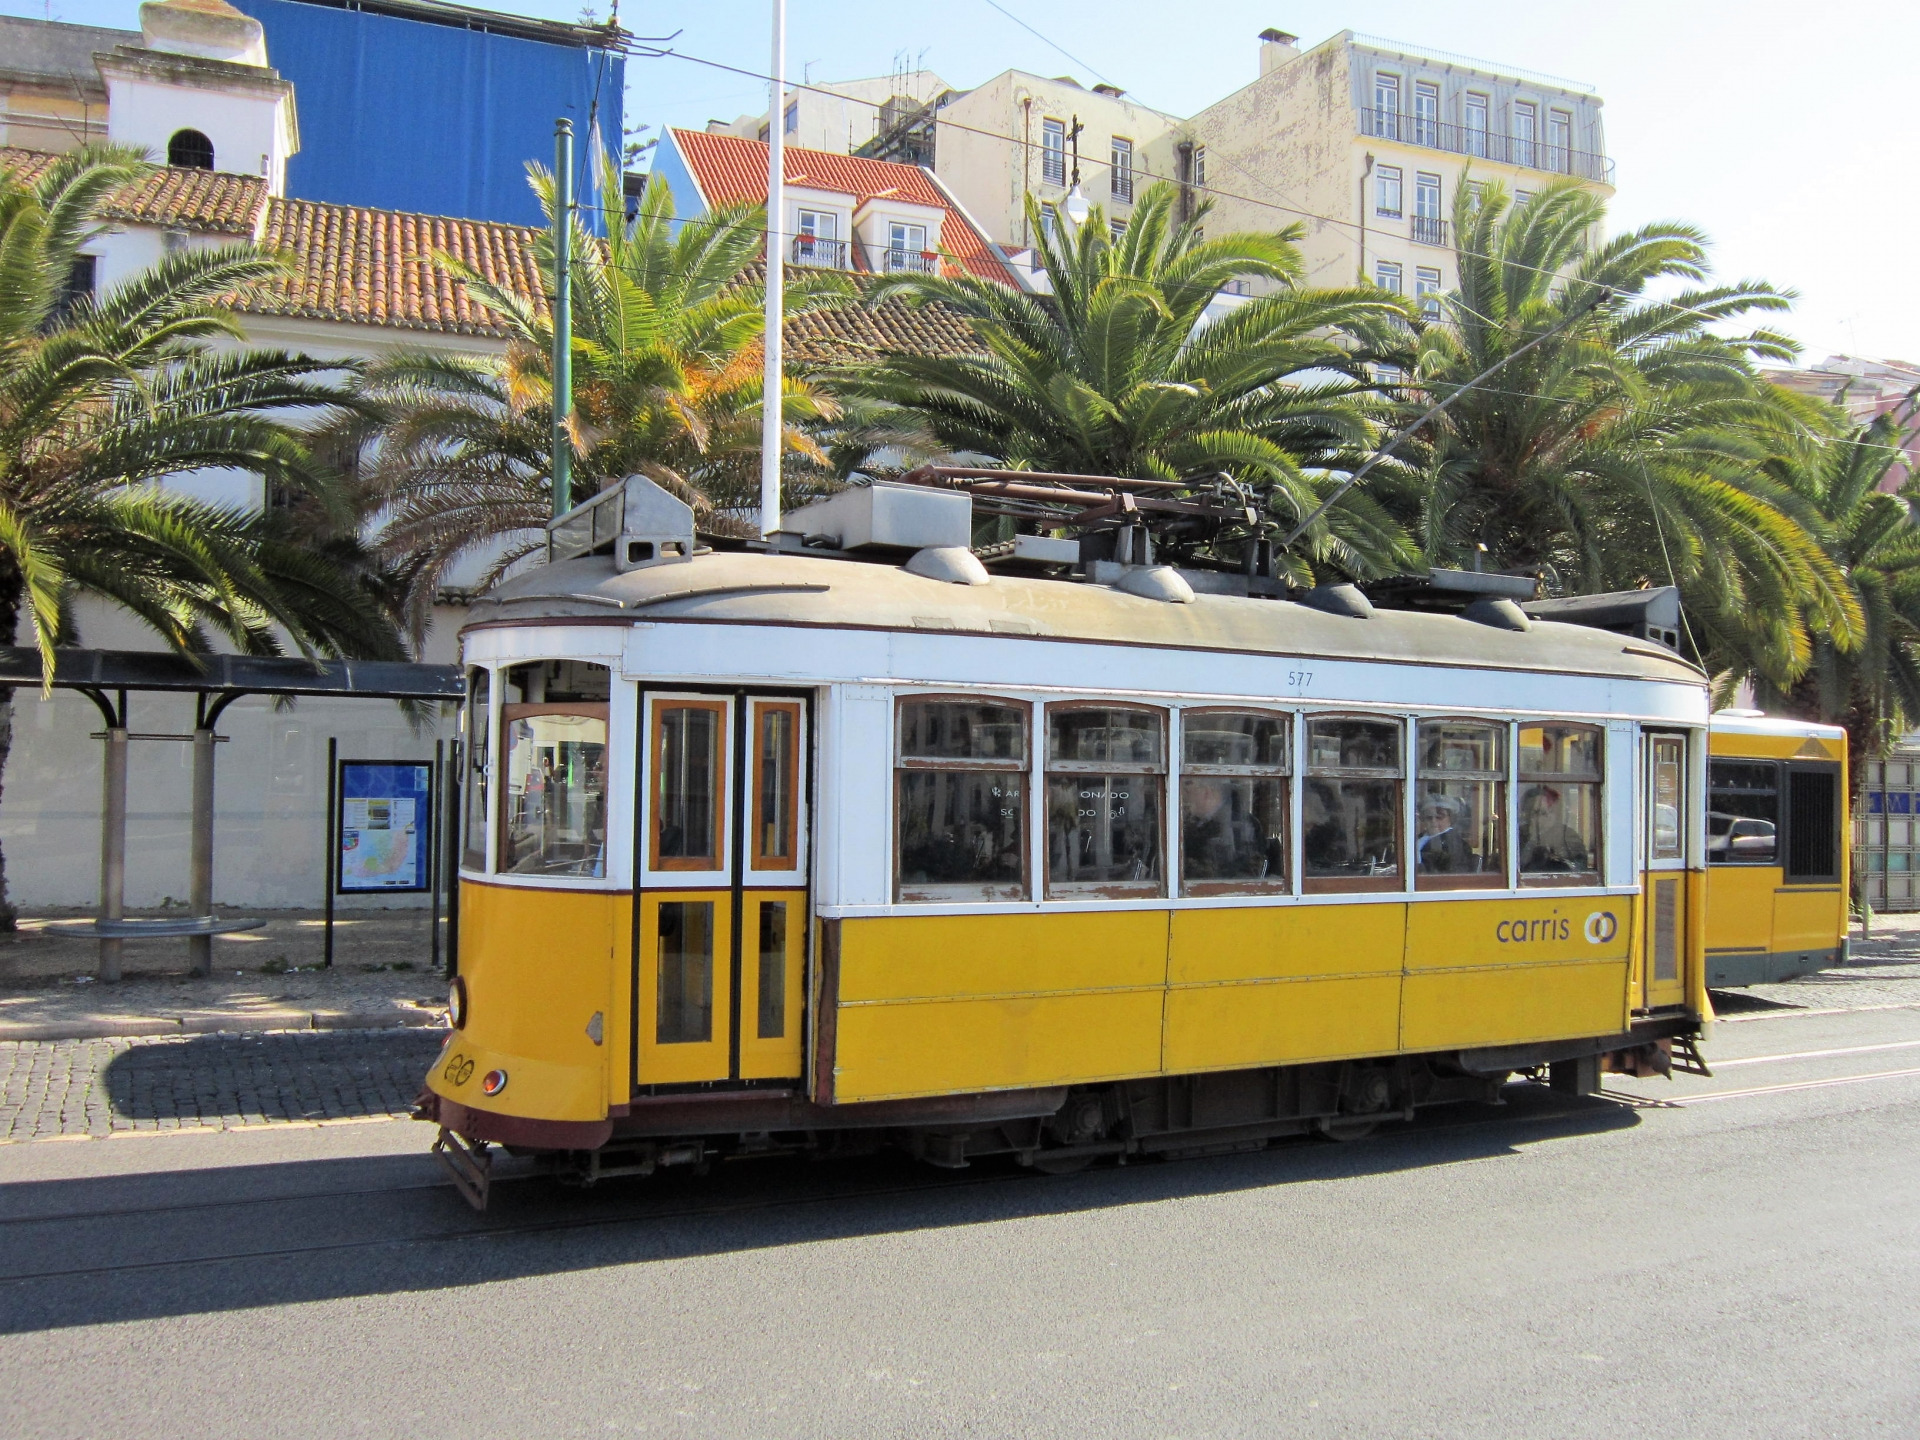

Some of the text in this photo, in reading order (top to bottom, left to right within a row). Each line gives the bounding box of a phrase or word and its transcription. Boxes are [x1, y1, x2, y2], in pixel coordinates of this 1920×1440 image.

[1288, 671, 1313, 687] 577
[1005, 790, 1020, 798] AR
[1496, 909, 1570, 943] carris
